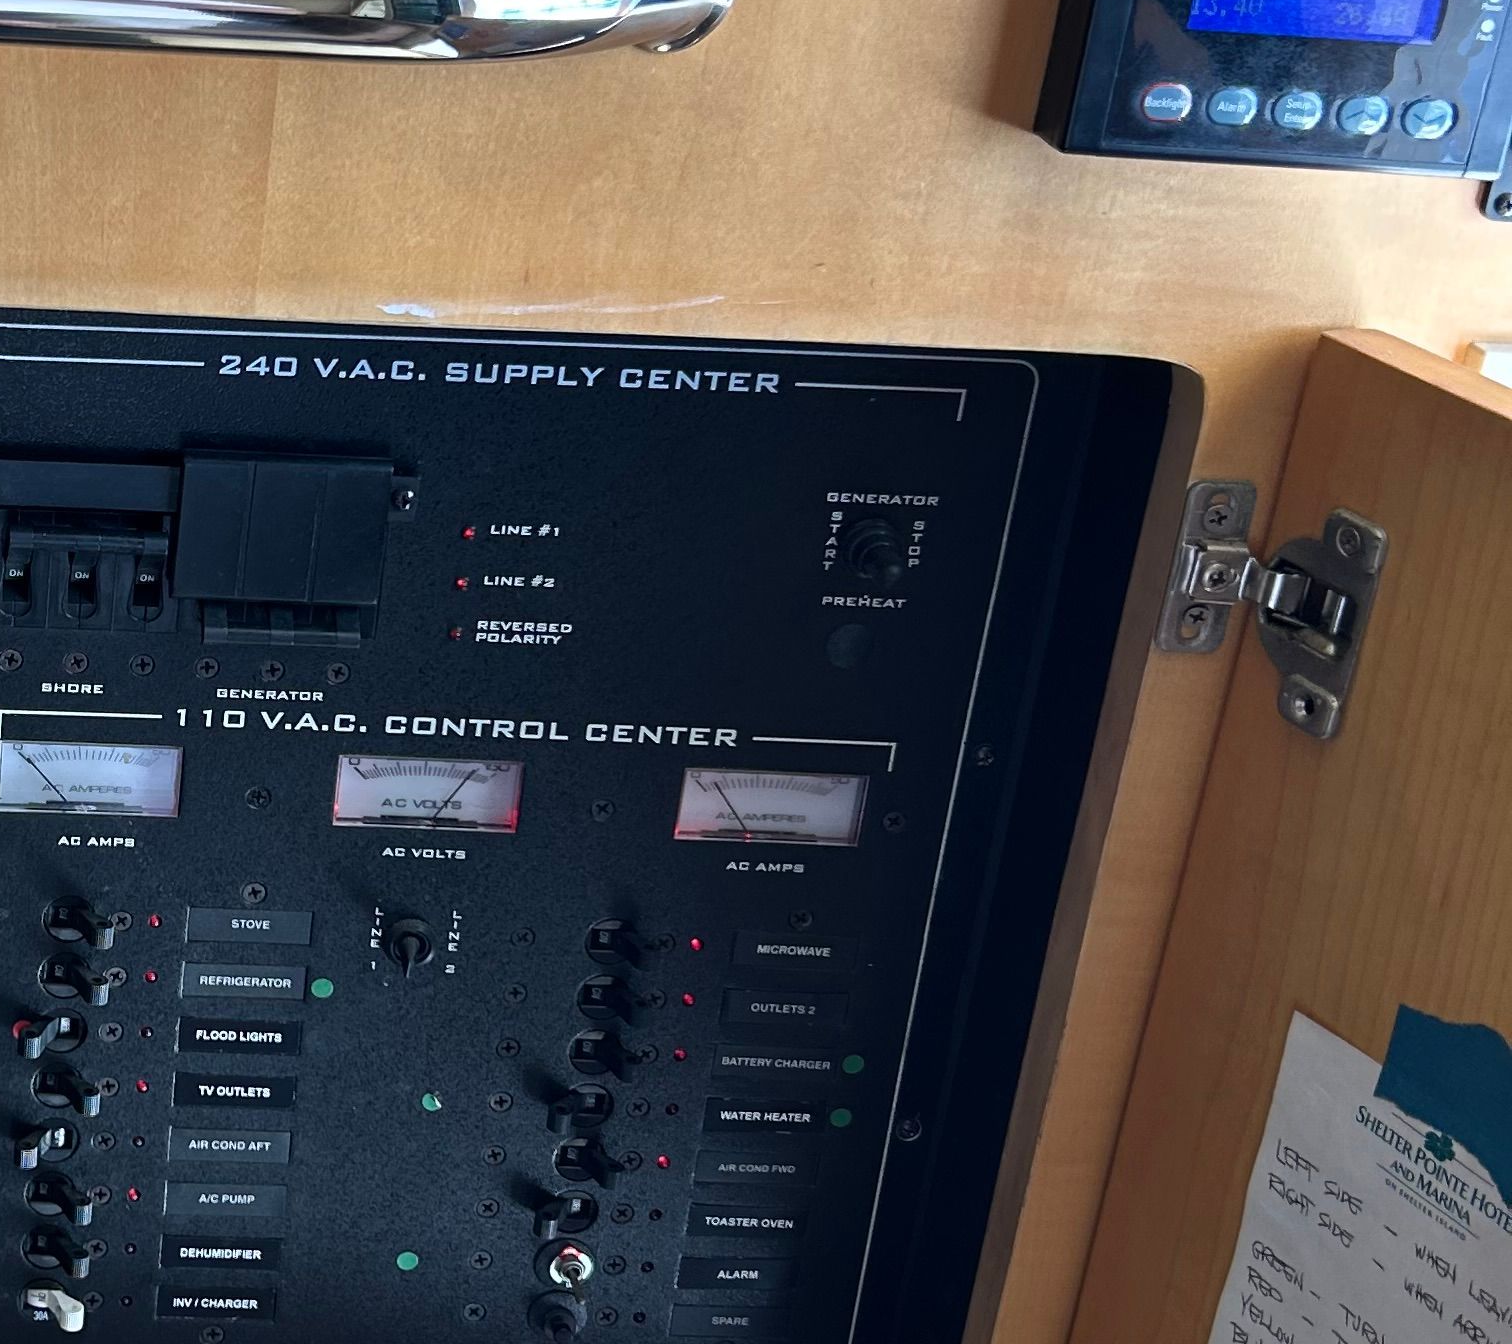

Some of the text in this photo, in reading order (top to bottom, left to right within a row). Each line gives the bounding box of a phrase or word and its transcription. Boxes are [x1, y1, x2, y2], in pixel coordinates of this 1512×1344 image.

[219, 355, 779, 394] 240 V.A.C. SUPPLY CENTER
[826, 492, 939, 506] GENERATOR
[489, 524, 560, 537] LINE #1
[483, 575, 555, 588] LINE #2
[822, 595, 906, 608] PREHEAT
[477, 621, 573, 633] REVERSED
[475, 632, 562, 646] POLARITY
[41, 682, 104, 695] SHORE
[216, 688, 324, 702] GENERATOR
[177, 709, 738, 748] 110 V.A.C. CONTROL CENTER
[58, 836, 134, 847] AC AMPS
[382, 847, 465, 860] AC VOLTS
[726, 862, 805, 873] AC AMPS
[231, 919, 270, 930] STOVE
[757, 944, 832, 957] MICROWAVE
[199, 976, 291, 988] REFRIGERATOR
[751, 1003, 816, 1015] OUTLETS 2
[196, 1030, 282, 1043] FLOOD LIGHTS
[721, 1057, 830, 1070] BATTERY CHARGER
[198, 1085, 271, 1098] TV OUTLETS
[720, 1111, 810, 1123] WATER HEATER
[189, 1140, 271, 1152] AIR COND AFT
[1355, 1105, 1469, 1199] SHELTER POINTE
[718, 1163, 796, 1174] AIR COND FWD
[1390, 1160, 1471, 1225] AND MARINA
[199, 1194, 255, 1205] A/C PUMP
[1268, 1172, 1316, 1216] RIGHT
[1318, 1212, 1354, 1248] SIDE
[1275, 1138, 1457, 1284] LEFT SIDE WHEN
[705, 1217, 793, 1229] TOASTER OVEN
[180, 1248, 261, 1260] DEHUMIDIFIER
[1252, 1240, 1304, 1291] GREEN
[717, 1269, 758, 1280] ALARM
[173, 1298, 192, 1308] INV
[201, 1298, 258, 1310] CHARGER
[711, 1316, 748, 1326] SPARE
